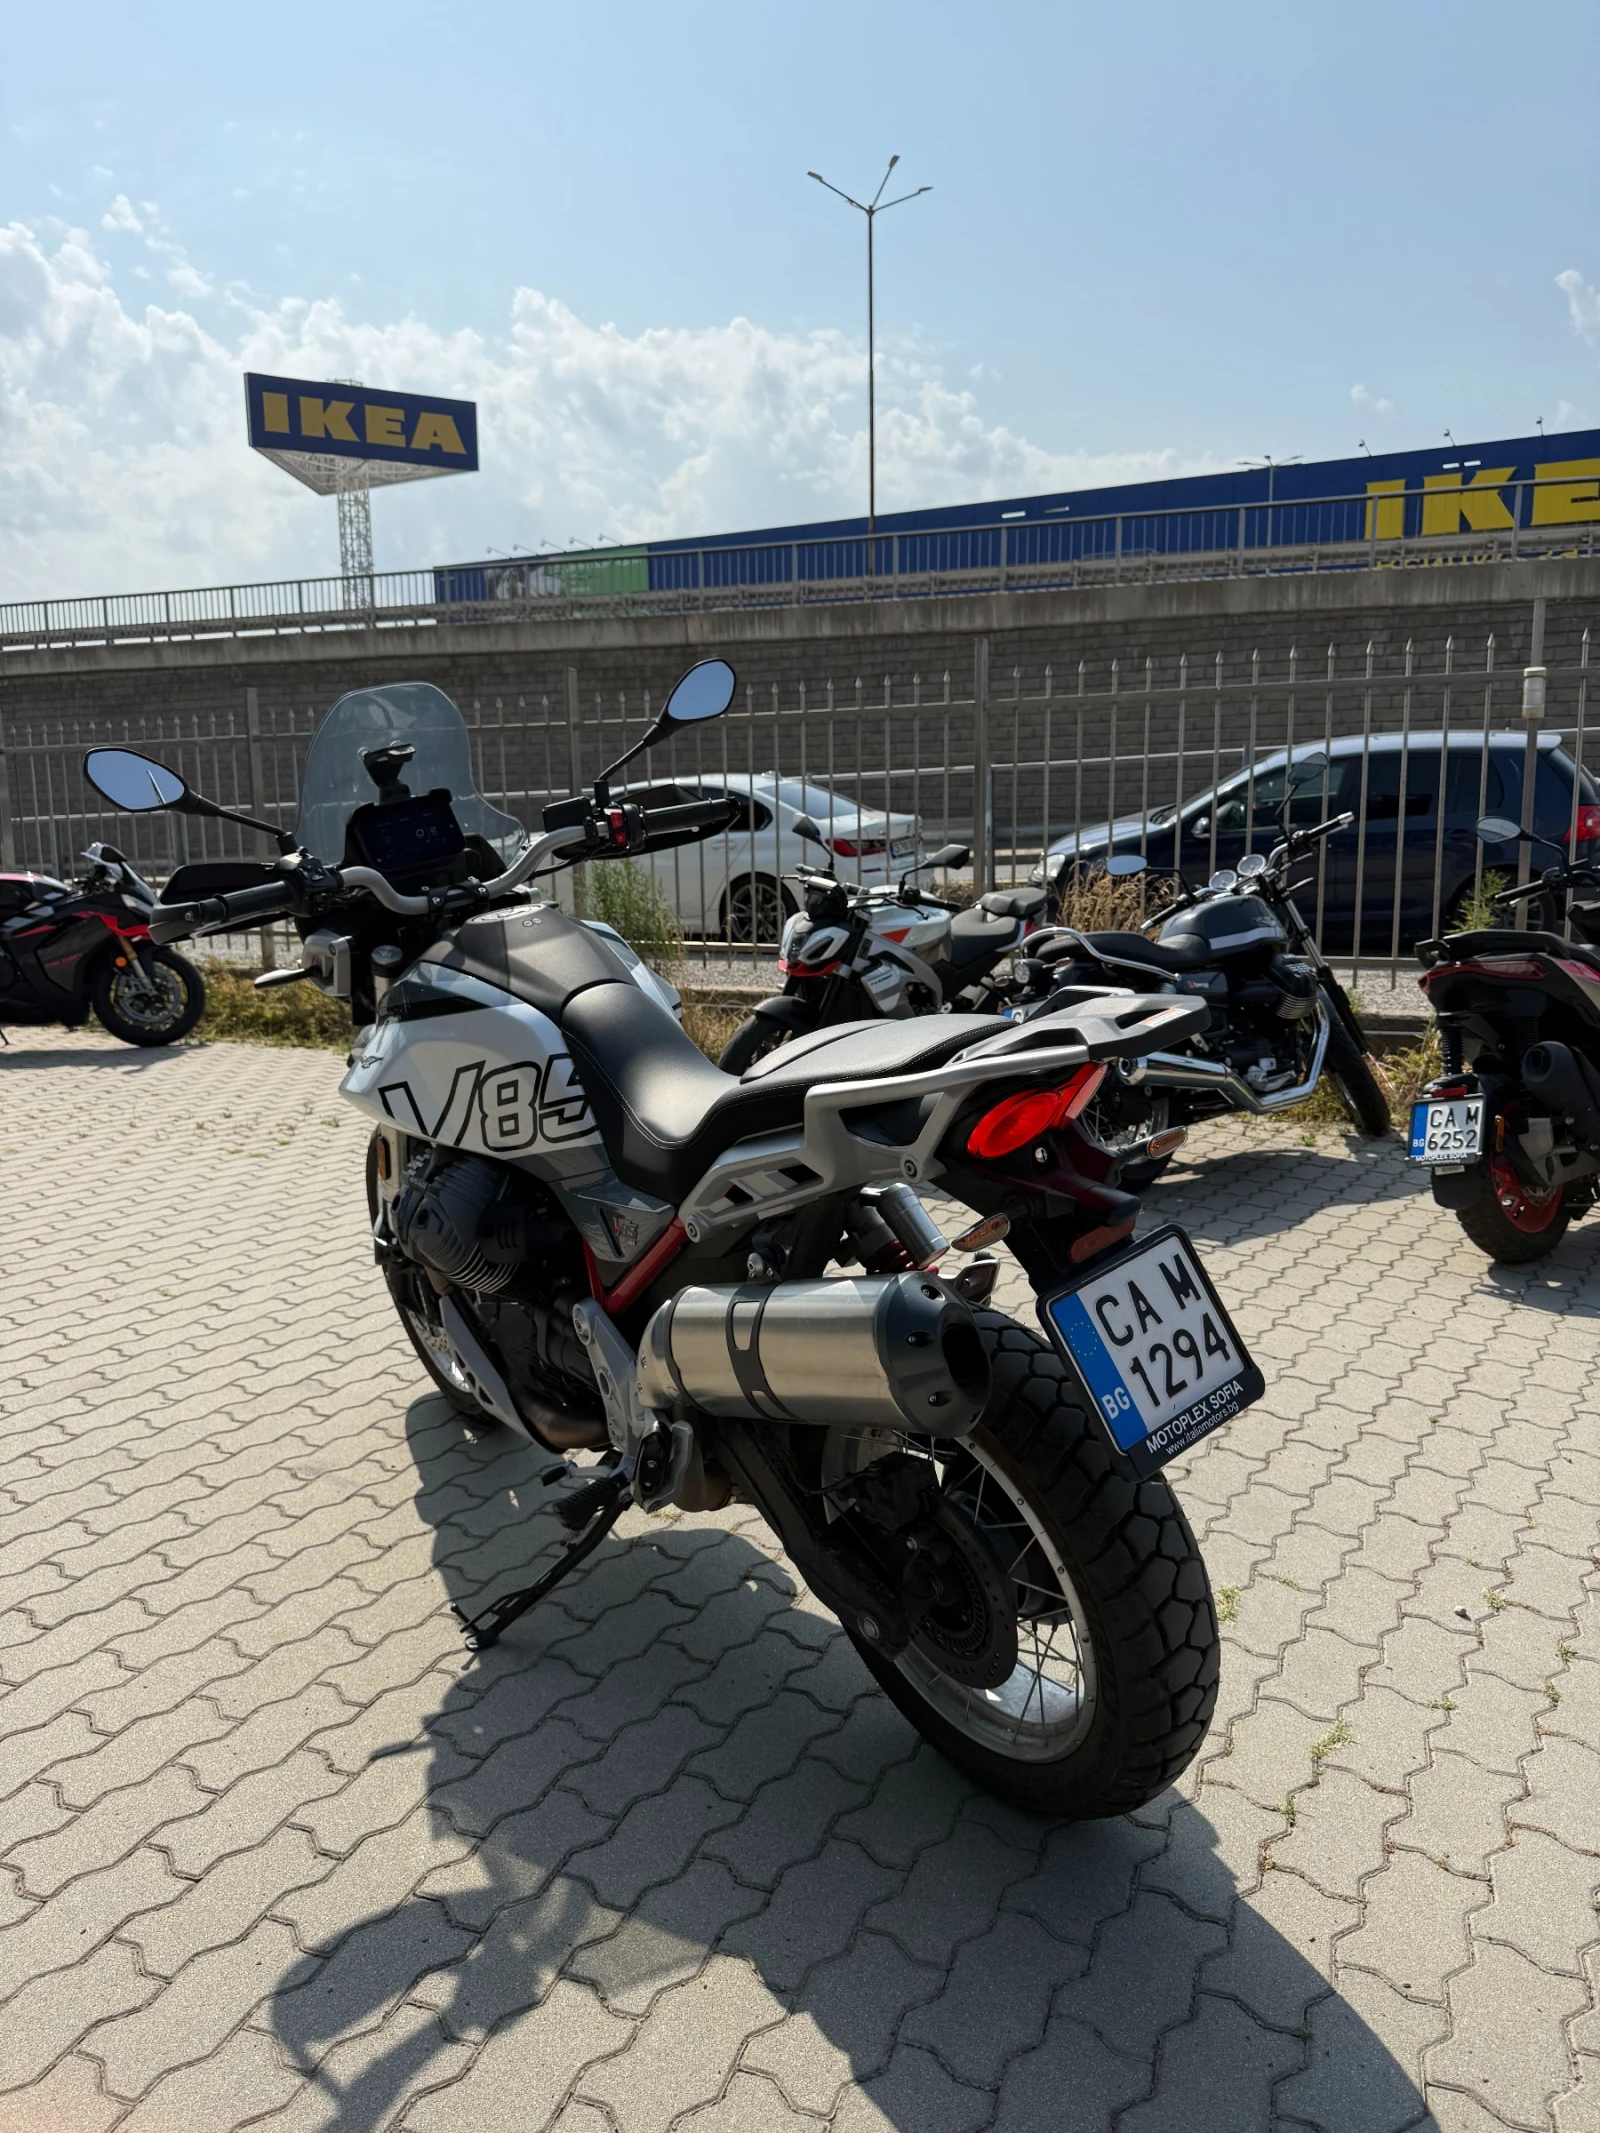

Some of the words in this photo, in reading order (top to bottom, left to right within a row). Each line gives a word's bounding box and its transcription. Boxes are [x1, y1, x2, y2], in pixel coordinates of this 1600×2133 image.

[262, 390, 467, 455] IKEA
[378, 1052, 599, 1152] V85
[1430, 1108, 1456, 1128] CA
[1465, 1106, 1479, 1126] M
[1412, 1138, 1425, 1148] BG
[1427, 1129, 1477, 1151] 6252
[1095, 1280, 1162, 1346] CA
[1159, 1254, 1201, 1310] M
[1130, 1312, 1231, 1408] 1294
[1101, 1386, 1130, 1420] BG
[1146, 1401, 1211, 1454] MOTOPLEX
[1209, 1380, 1243, 1409] SOFIA
[1166, 1401, 1239, 1455] www.italiamotors.bg
